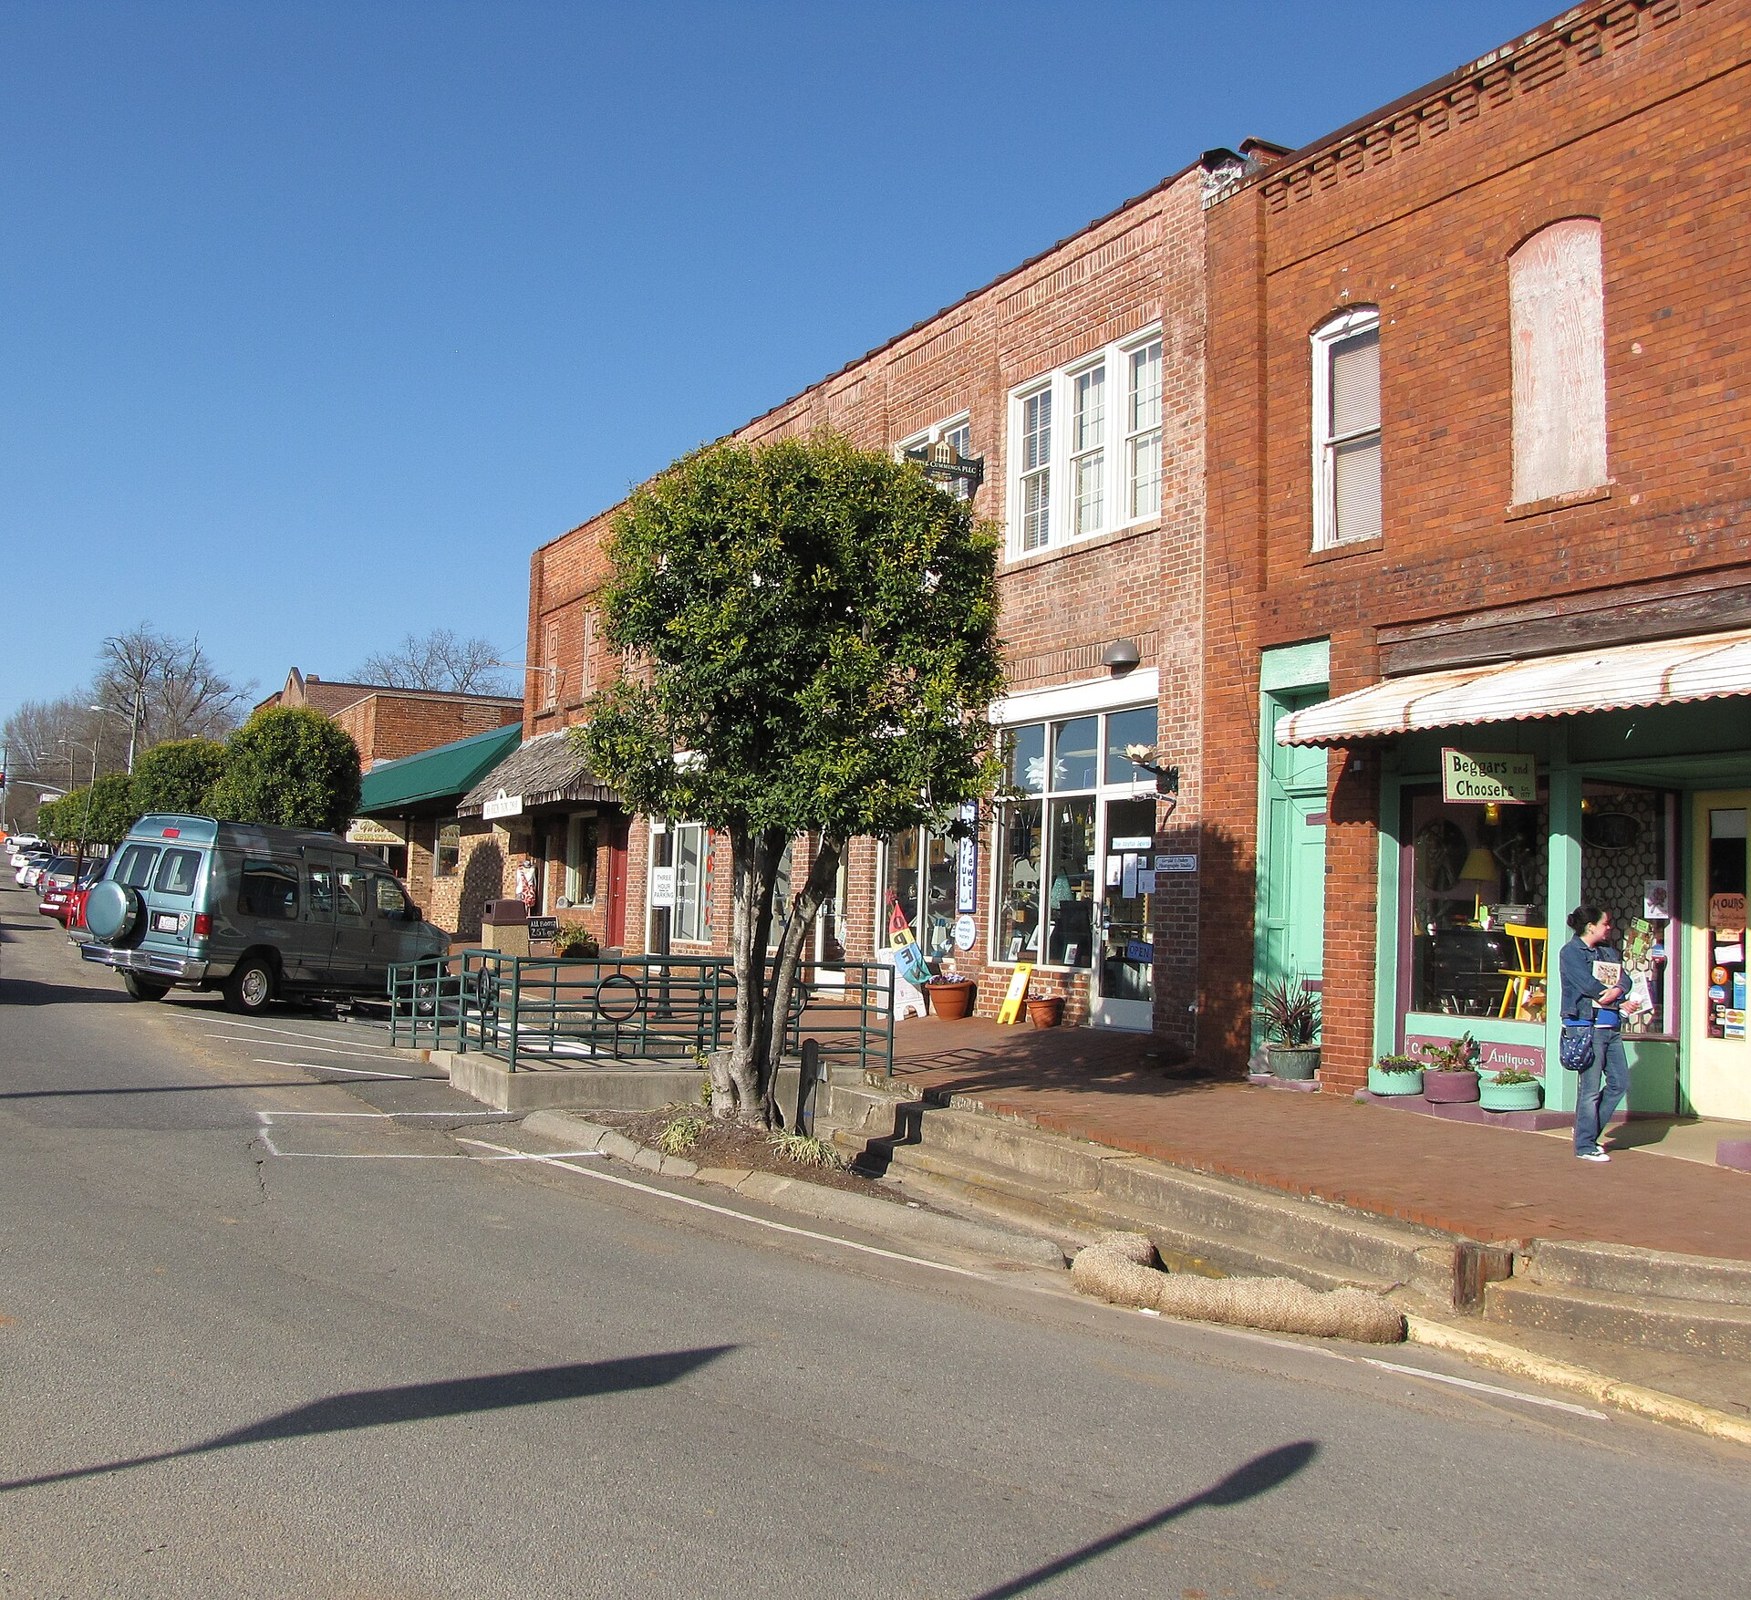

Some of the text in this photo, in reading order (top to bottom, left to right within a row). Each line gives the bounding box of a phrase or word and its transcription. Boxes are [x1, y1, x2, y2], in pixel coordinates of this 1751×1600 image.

[1452, 755, 1528, 777] Beggars and
[1456, 780, 1514, 797] Choosers
[1712, 897, 1745, 911] HOURS
[1129, 946, 1149, 958] OPEN
[1486, 1047, 1536, 1070] Antiques
